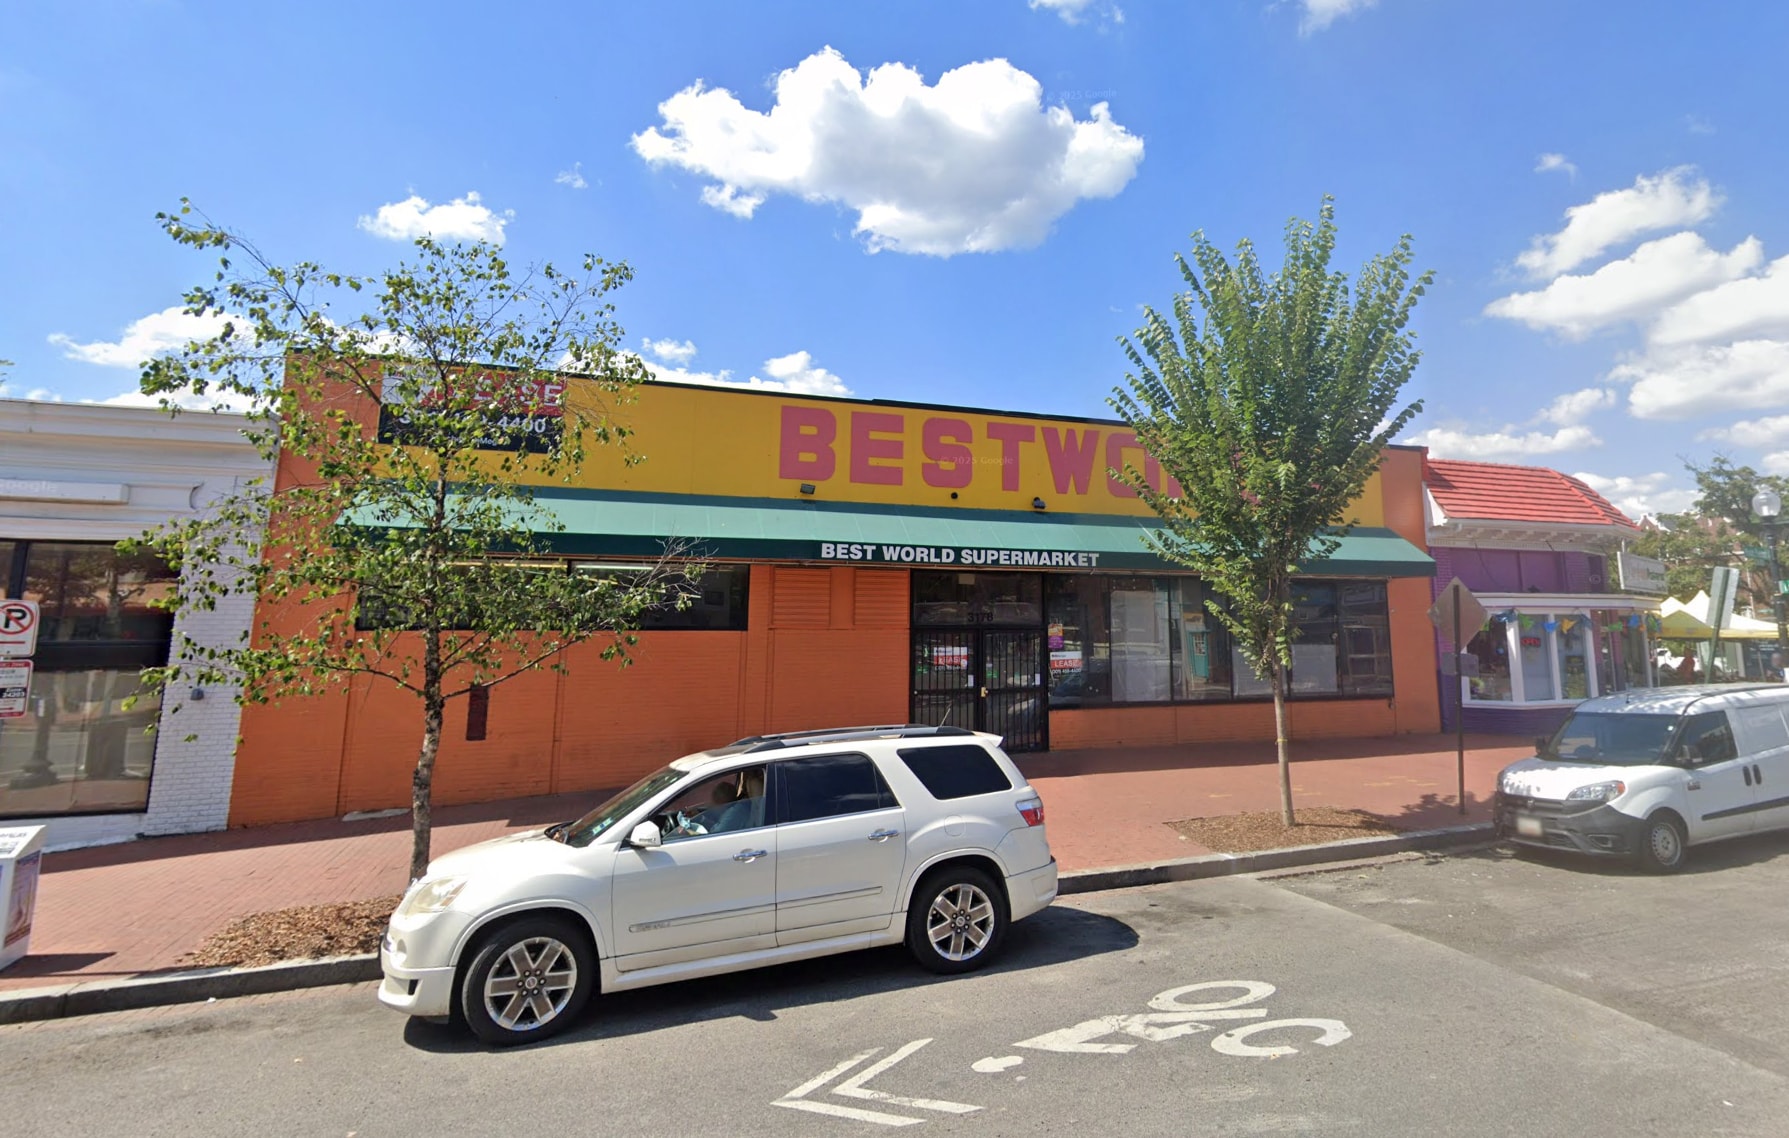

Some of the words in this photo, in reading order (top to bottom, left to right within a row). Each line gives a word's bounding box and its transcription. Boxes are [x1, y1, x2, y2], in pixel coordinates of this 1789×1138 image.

[821, 543, 876, 560] BEST
[882, 545, 955, 563] WORLD
[960, 549, 1099, 567] SUPERMARKET
[967, 612, 994, 623] 3178
